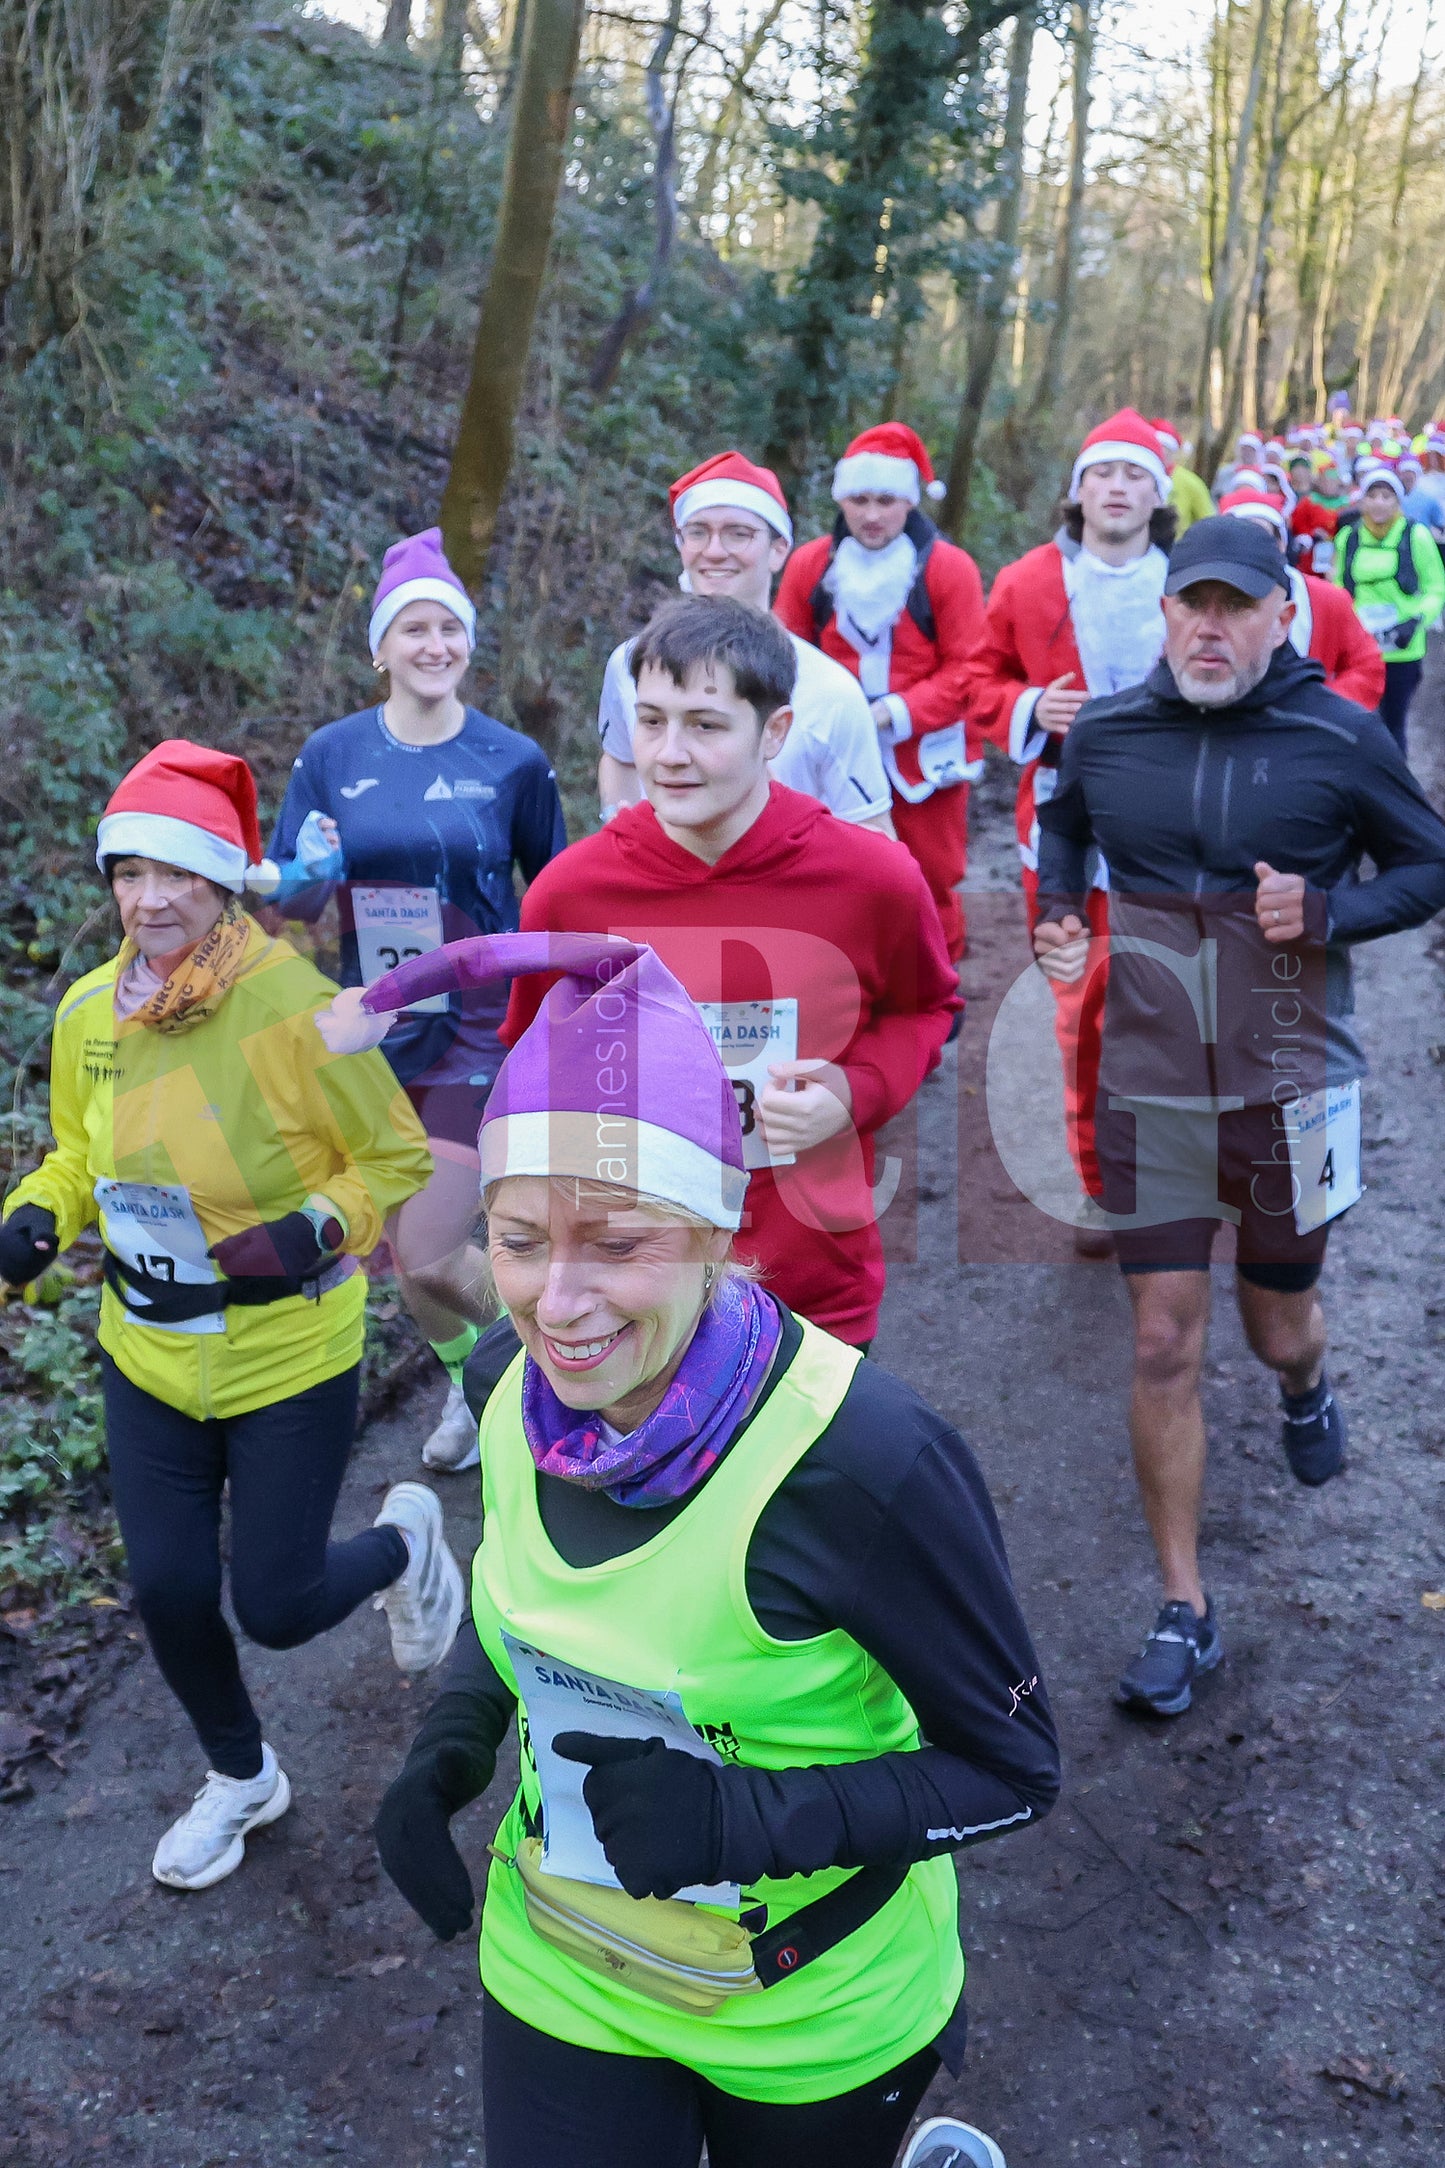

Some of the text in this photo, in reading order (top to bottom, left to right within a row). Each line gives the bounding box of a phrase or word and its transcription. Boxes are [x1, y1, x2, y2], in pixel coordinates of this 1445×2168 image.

[365, 907, 428, 918] SANTA DASH
[737, 1025, 780, 1040] DASH
[1318, 1147, 1335, 1191] 4
[110, 1200, 185, 1220] SANTA DASH
[534, 1665, 612, 1701] SANTA
